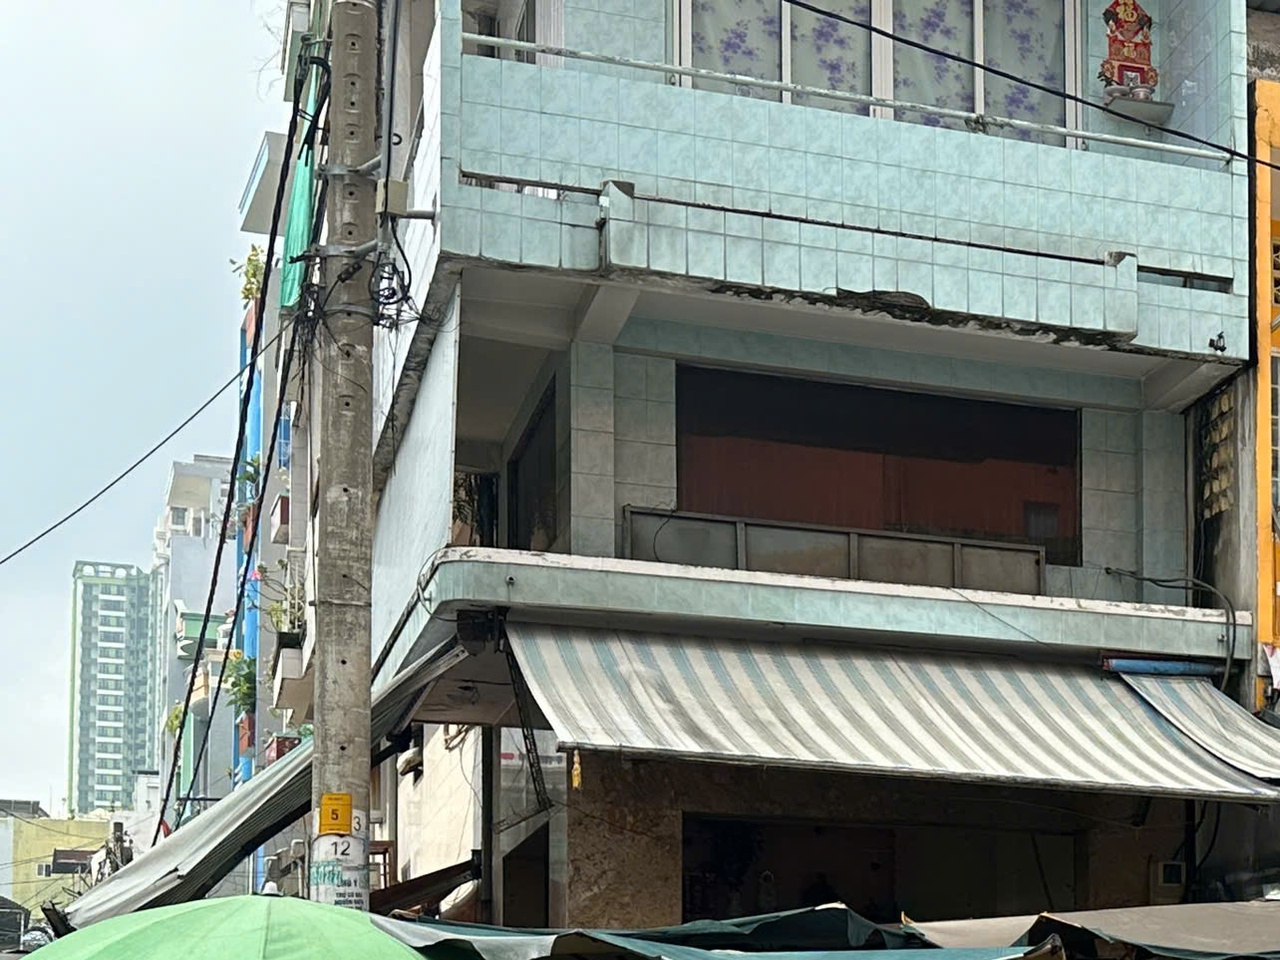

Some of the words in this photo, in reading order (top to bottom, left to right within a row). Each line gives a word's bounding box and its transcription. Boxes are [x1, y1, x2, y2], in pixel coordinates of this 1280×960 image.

[331, 808, 339, 821] 5
[353, 815, 362, 831] 3
[331, 840, 351, 856] 12
